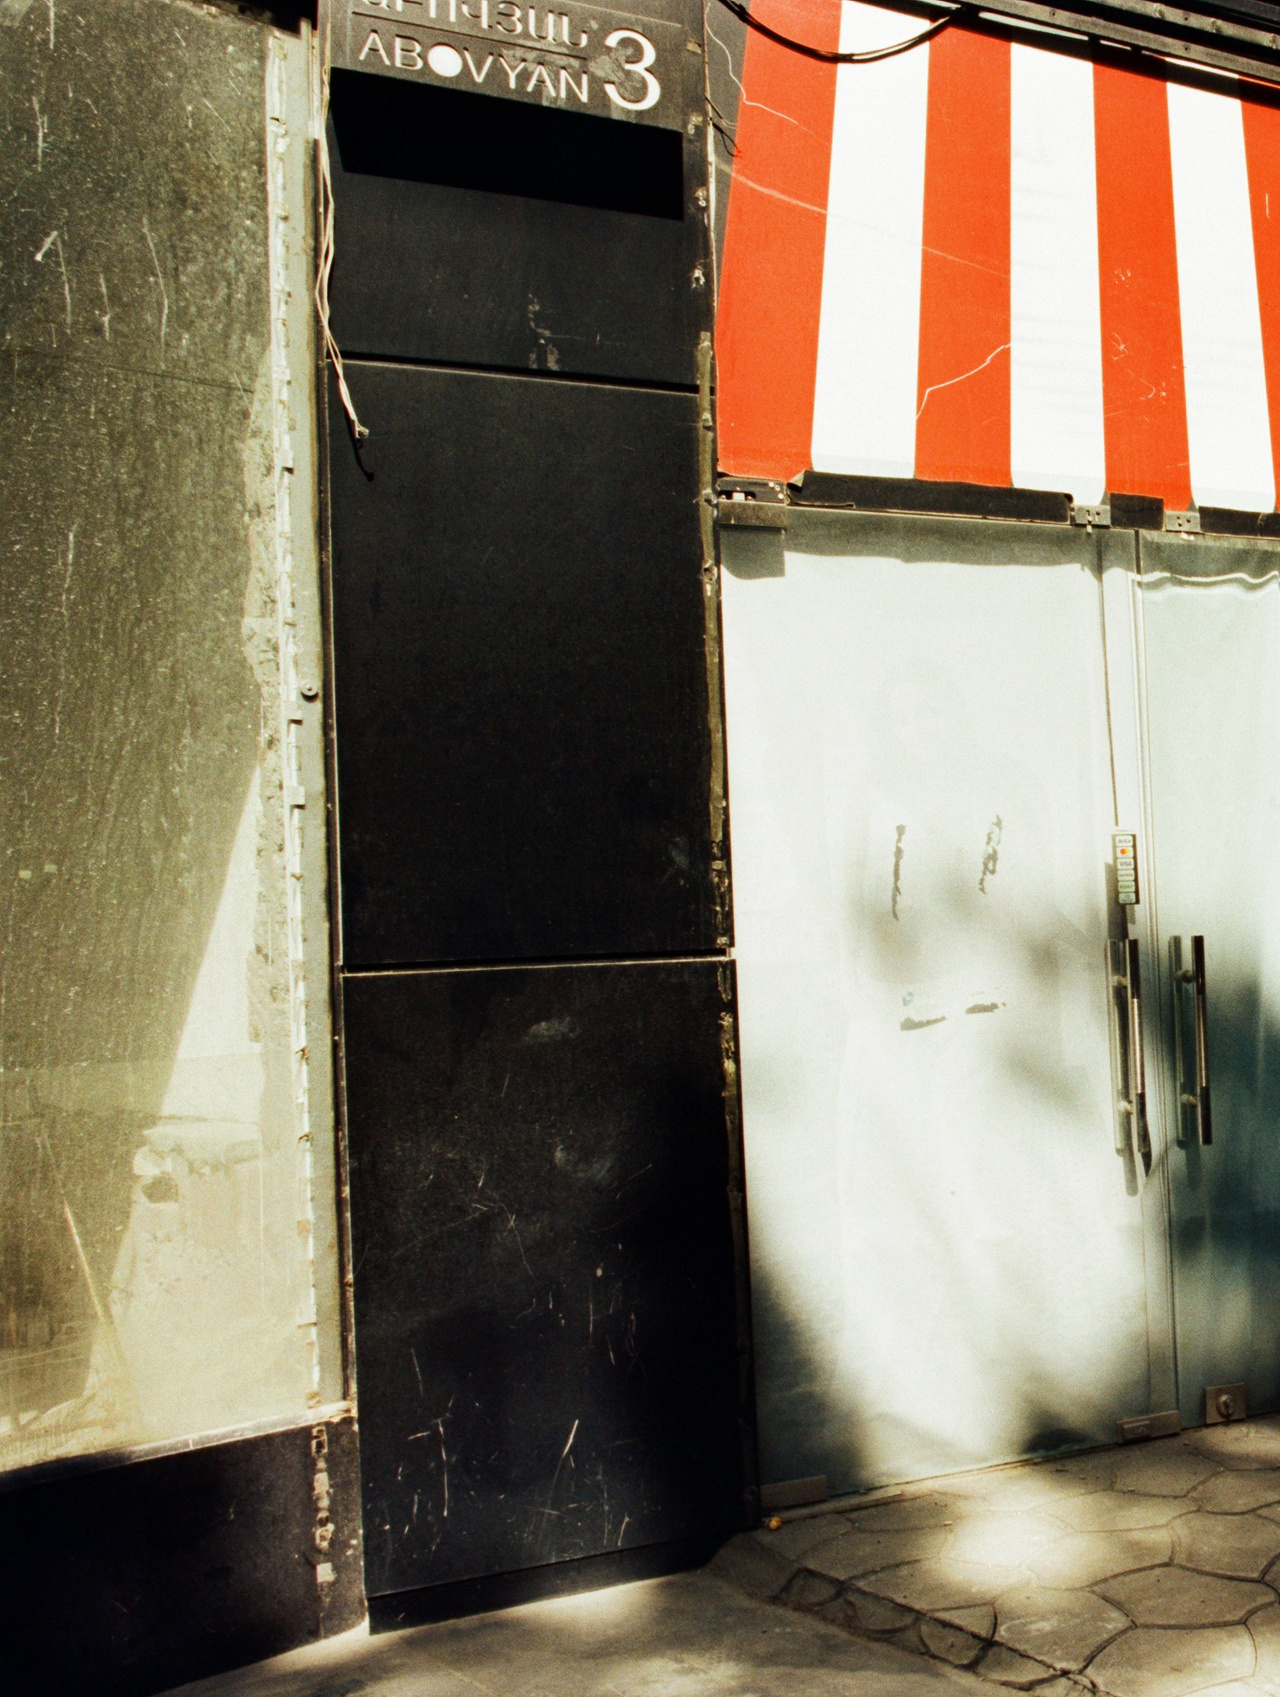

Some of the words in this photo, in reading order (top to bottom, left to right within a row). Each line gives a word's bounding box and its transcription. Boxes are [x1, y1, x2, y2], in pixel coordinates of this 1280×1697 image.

[363, 0, 588, 48] ՈՎՅԱՆ
[359, 29, 588, 103] ABOVYAN
[604, 28, 661, 111] 3
